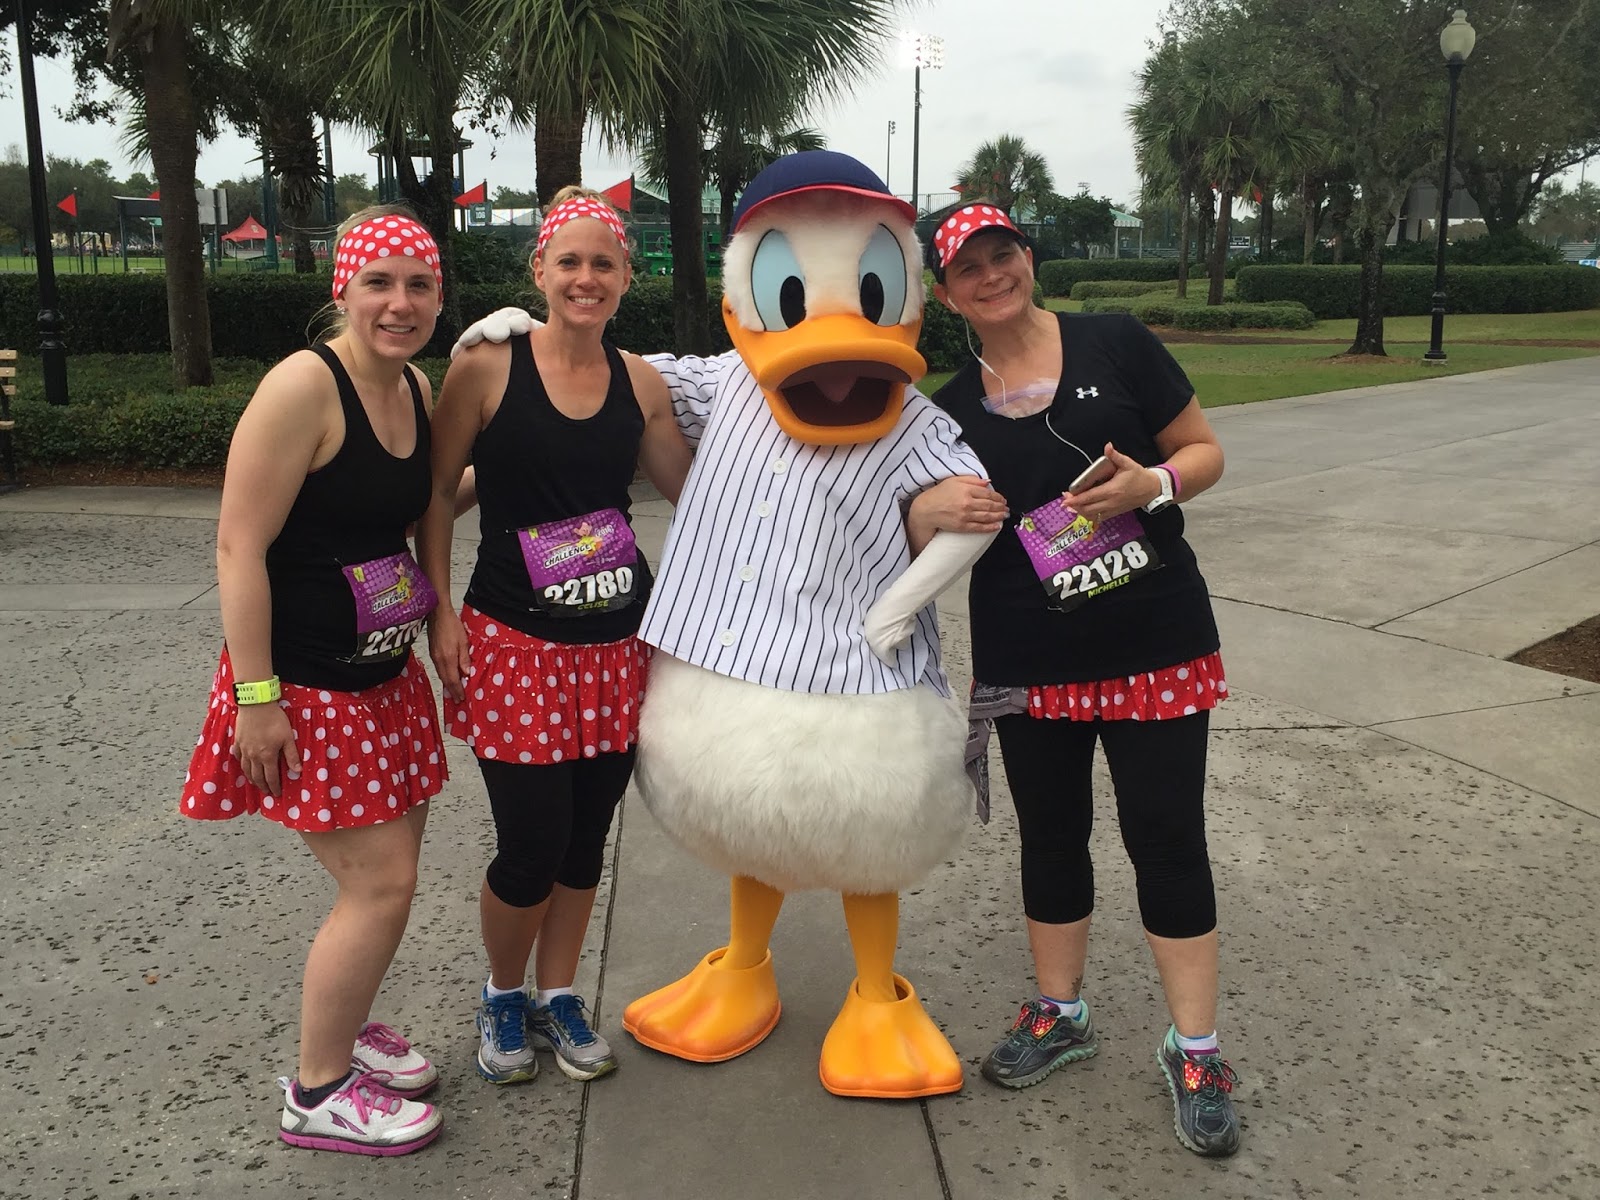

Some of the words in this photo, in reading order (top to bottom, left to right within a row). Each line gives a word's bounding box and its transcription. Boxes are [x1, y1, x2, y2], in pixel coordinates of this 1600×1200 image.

[544, 544, 591, 568] CHALLENGE
[1046, 525, 1089, 557] CHALLENGE
[544, 566, 633, 606] 22780
[1052, 541, 1149, 600] 22128
[1088, 575, 1130, 599] MICHELLE
